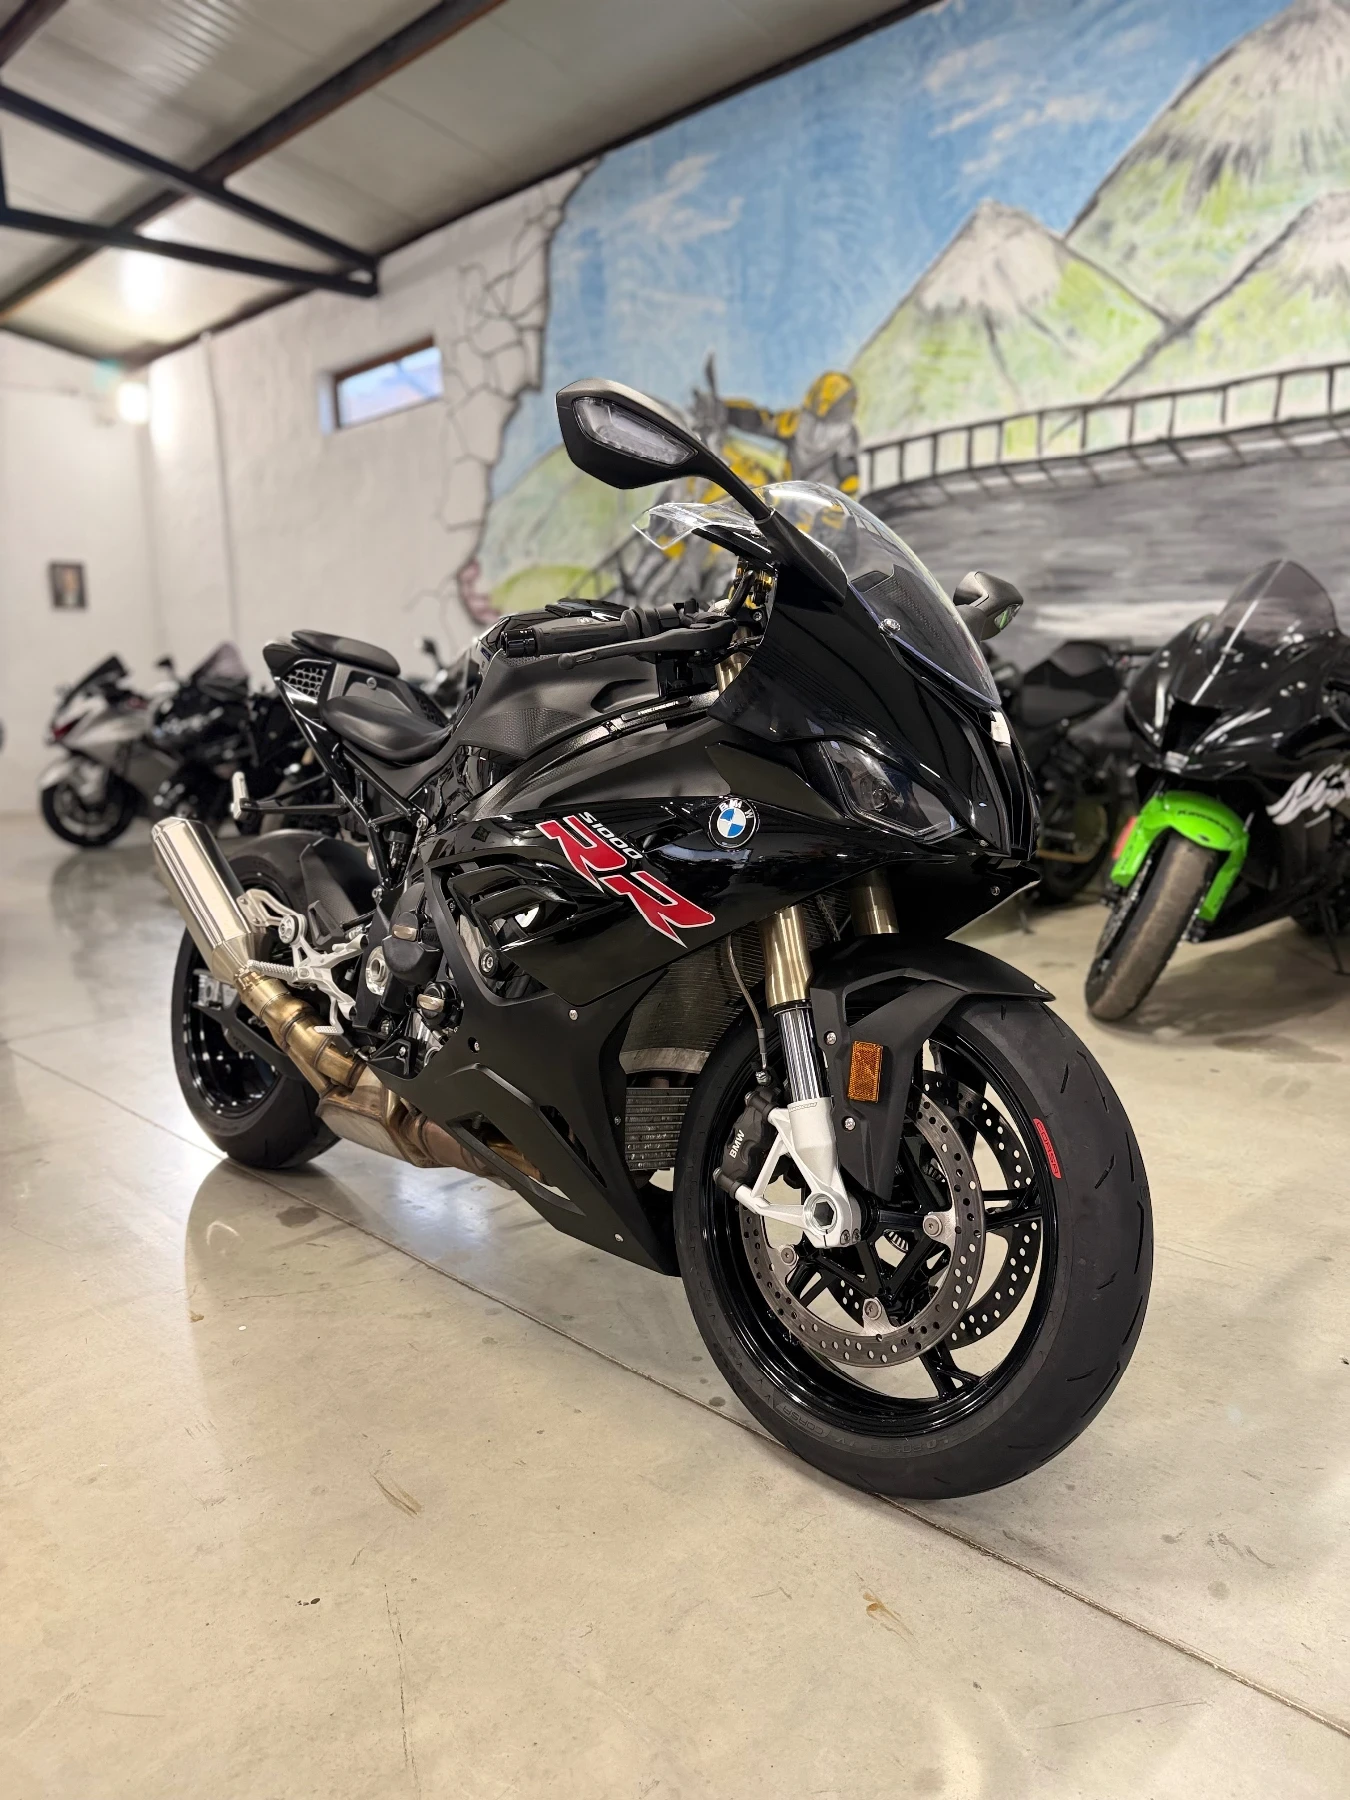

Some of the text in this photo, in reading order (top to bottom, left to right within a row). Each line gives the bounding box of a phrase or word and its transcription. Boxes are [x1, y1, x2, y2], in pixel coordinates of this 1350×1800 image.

[718, 798, 755, 819] BMW
[578, 811, 644, 860] S1000
[535, 814, 716, 949] RR
[729, 1129, 745, 1158] BMW
[781, 1405, 824, 1435] CORSA
